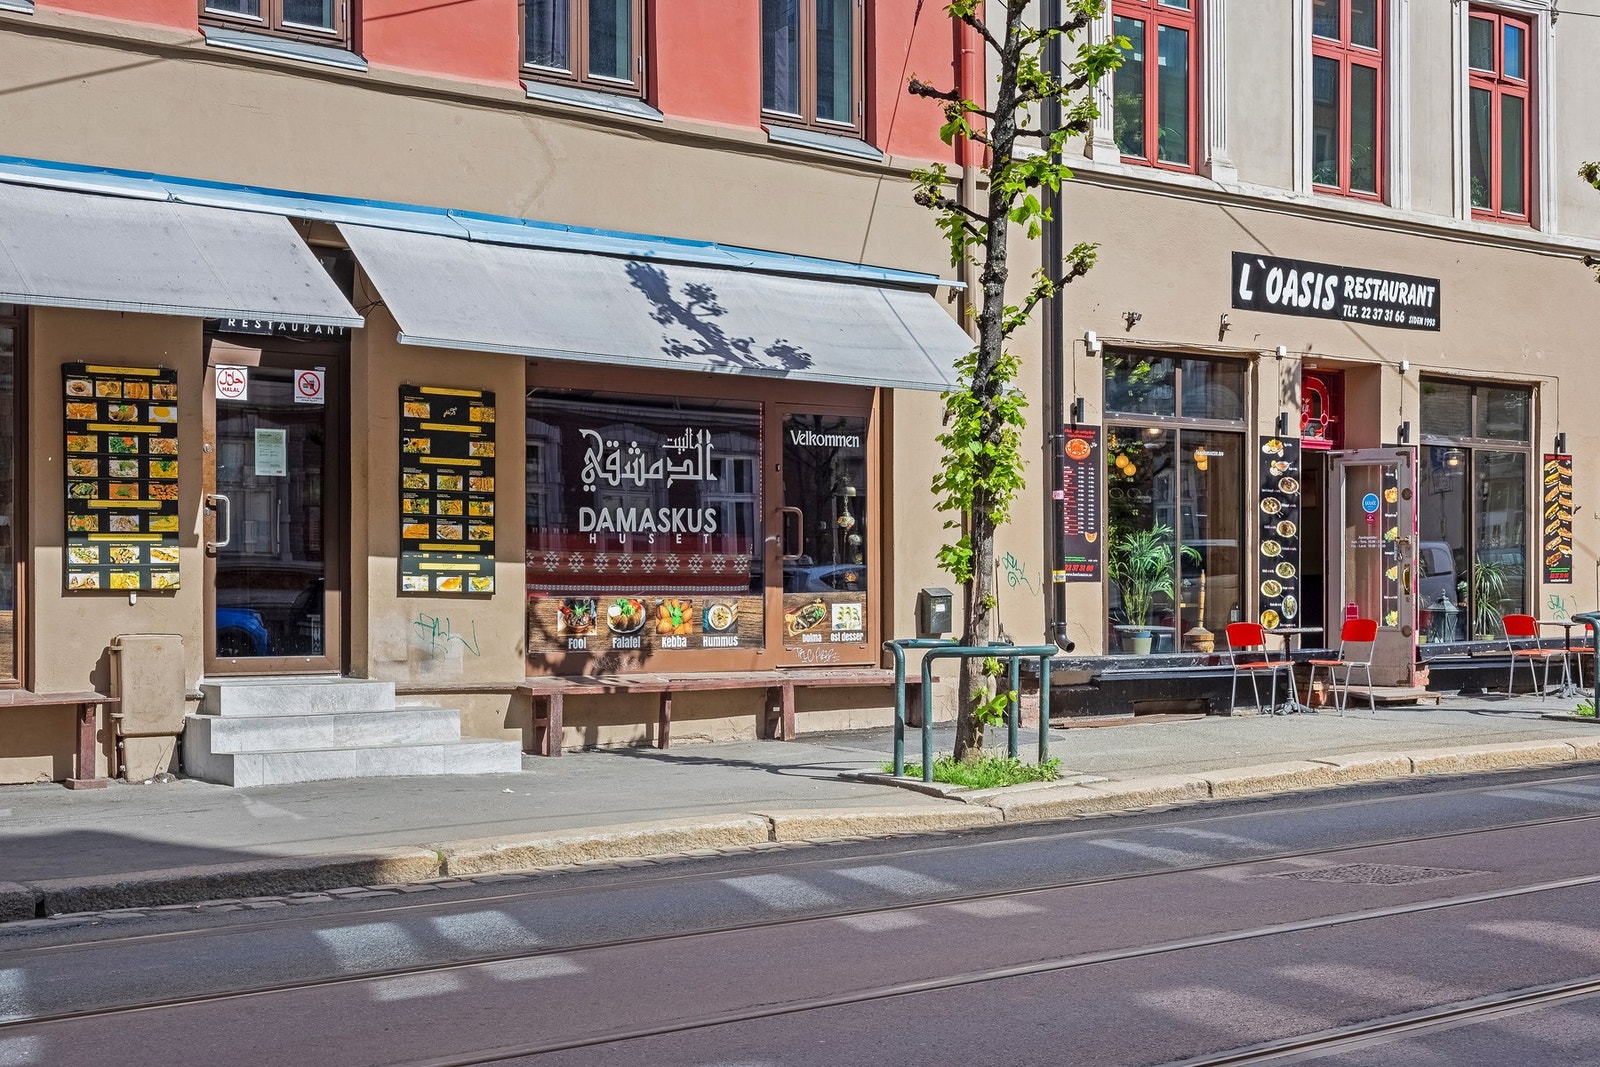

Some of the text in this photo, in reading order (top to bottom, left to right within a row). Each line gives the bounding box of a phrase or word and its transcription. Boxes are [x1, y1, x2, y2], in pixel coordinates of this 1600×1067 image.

[1343, 275, 1435, 308] RESTAURANT
[1343, 304, 1405, 323] TLF. 22 37 31 66
[228, 318, 345, 336] RESTAURANT
[1408, 315, 1436, 327] SIDEN 1993
[219, 371, 243, 386] حلال
[790, 430, 860, 448] Velkommen
[579, 428, 718, 492] الدمشقي
[579, 506, 718, 533] DAMASKUS
[589, 533, 709, 544] HUSET
[568, 636, 587, 649] Fool
[612, 635, 641, 649] Falafel
[661, 635, 687, 648] Kebba
[703, 635, 739, 647] Hummus
[802, 632, 822, 643] Dolma
